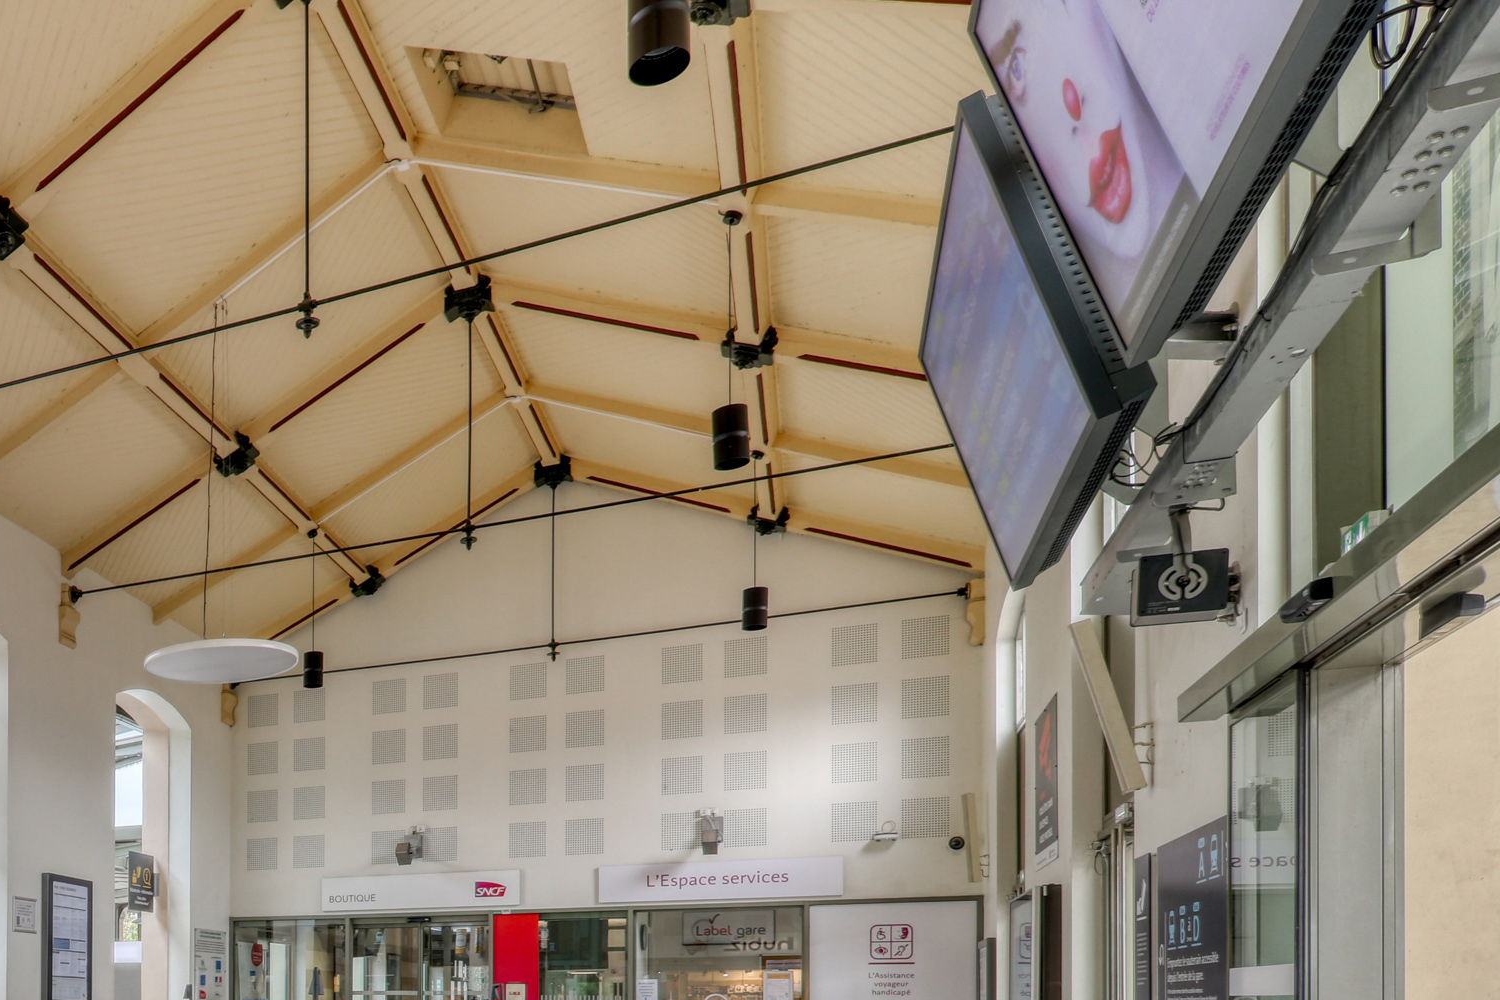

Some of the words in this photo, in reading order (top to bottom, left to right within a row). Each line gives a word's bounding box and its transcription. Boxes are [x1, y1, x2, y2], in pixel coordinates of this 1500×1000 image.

[1198, 852, 1206, 878] A
[646, 874, 716, 890] L'Espace
[722, 872, 789, 885] services
[329, 894, 376, 903] BOUTIQUE
[476, 885, 506, 897] SNCF
[696, 926, 732, 936] Label
[737, 926, 766, 938] gare
[1180, 918, 1186, 944] B
[1193, 915, 1200, 942] D
